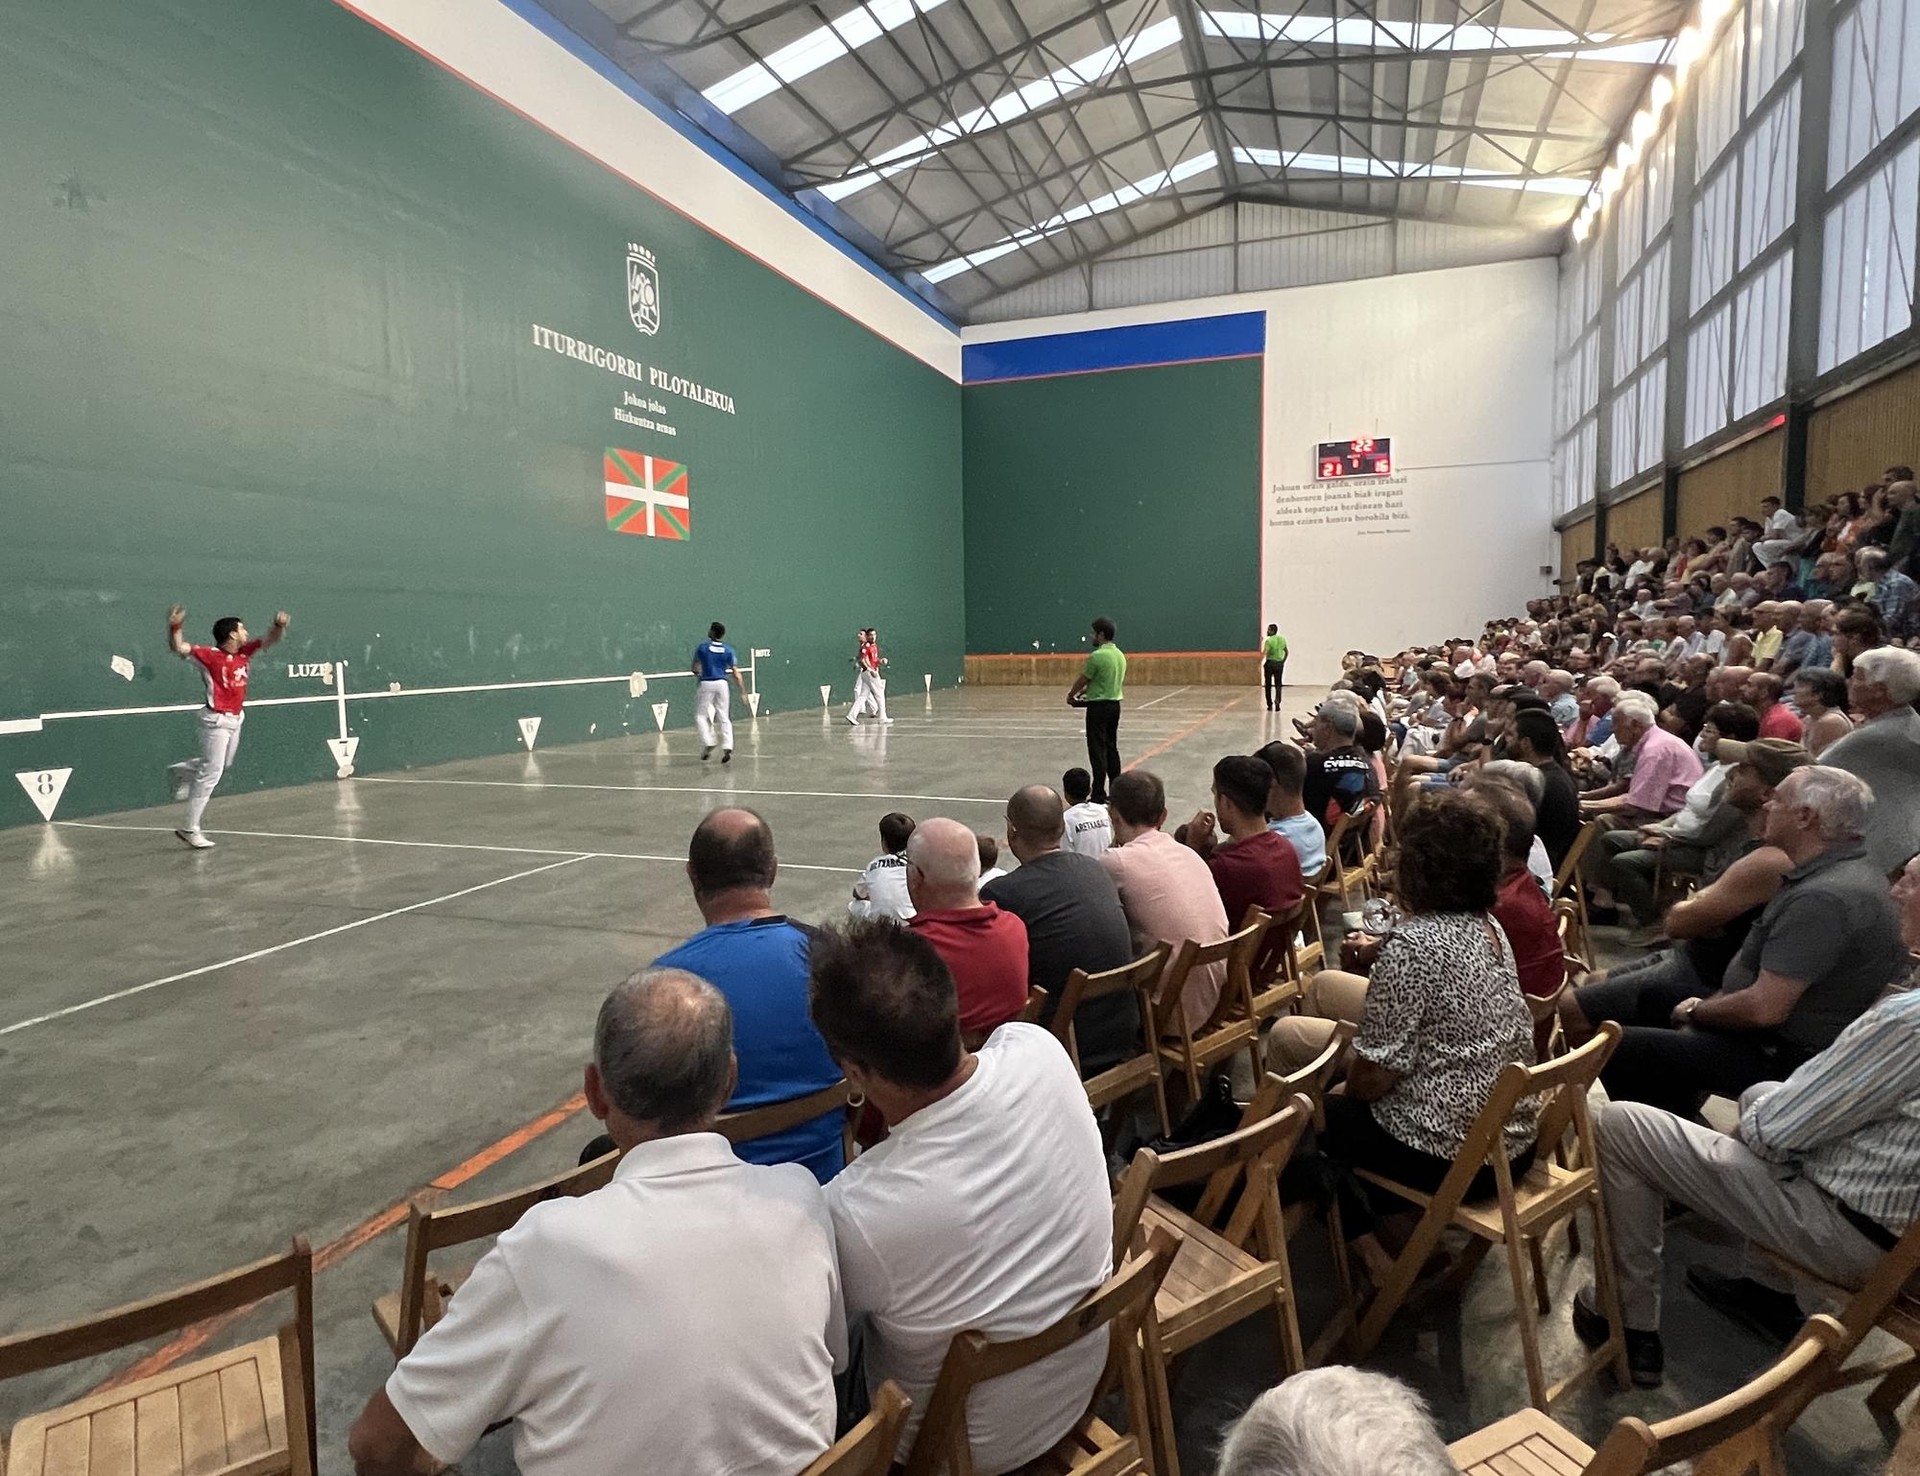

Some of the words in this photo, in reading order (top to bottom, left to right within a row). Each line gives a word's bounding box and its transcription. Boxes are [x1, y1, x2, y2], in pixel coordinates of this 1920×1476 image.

[532, 323, 642, 381] ITURRIGORRI
[649, 367, 736, 415] PILOTALEKUA
[647, 398, 667, 416] jolas
[613, 407, 655, 430] Hizkuntza
[1322, 462, 1343, 477] 21
[1374, 459, 1389, 473] 16
[524, 719, 534, 735] 6
[37, 772, 54, 796] 8
